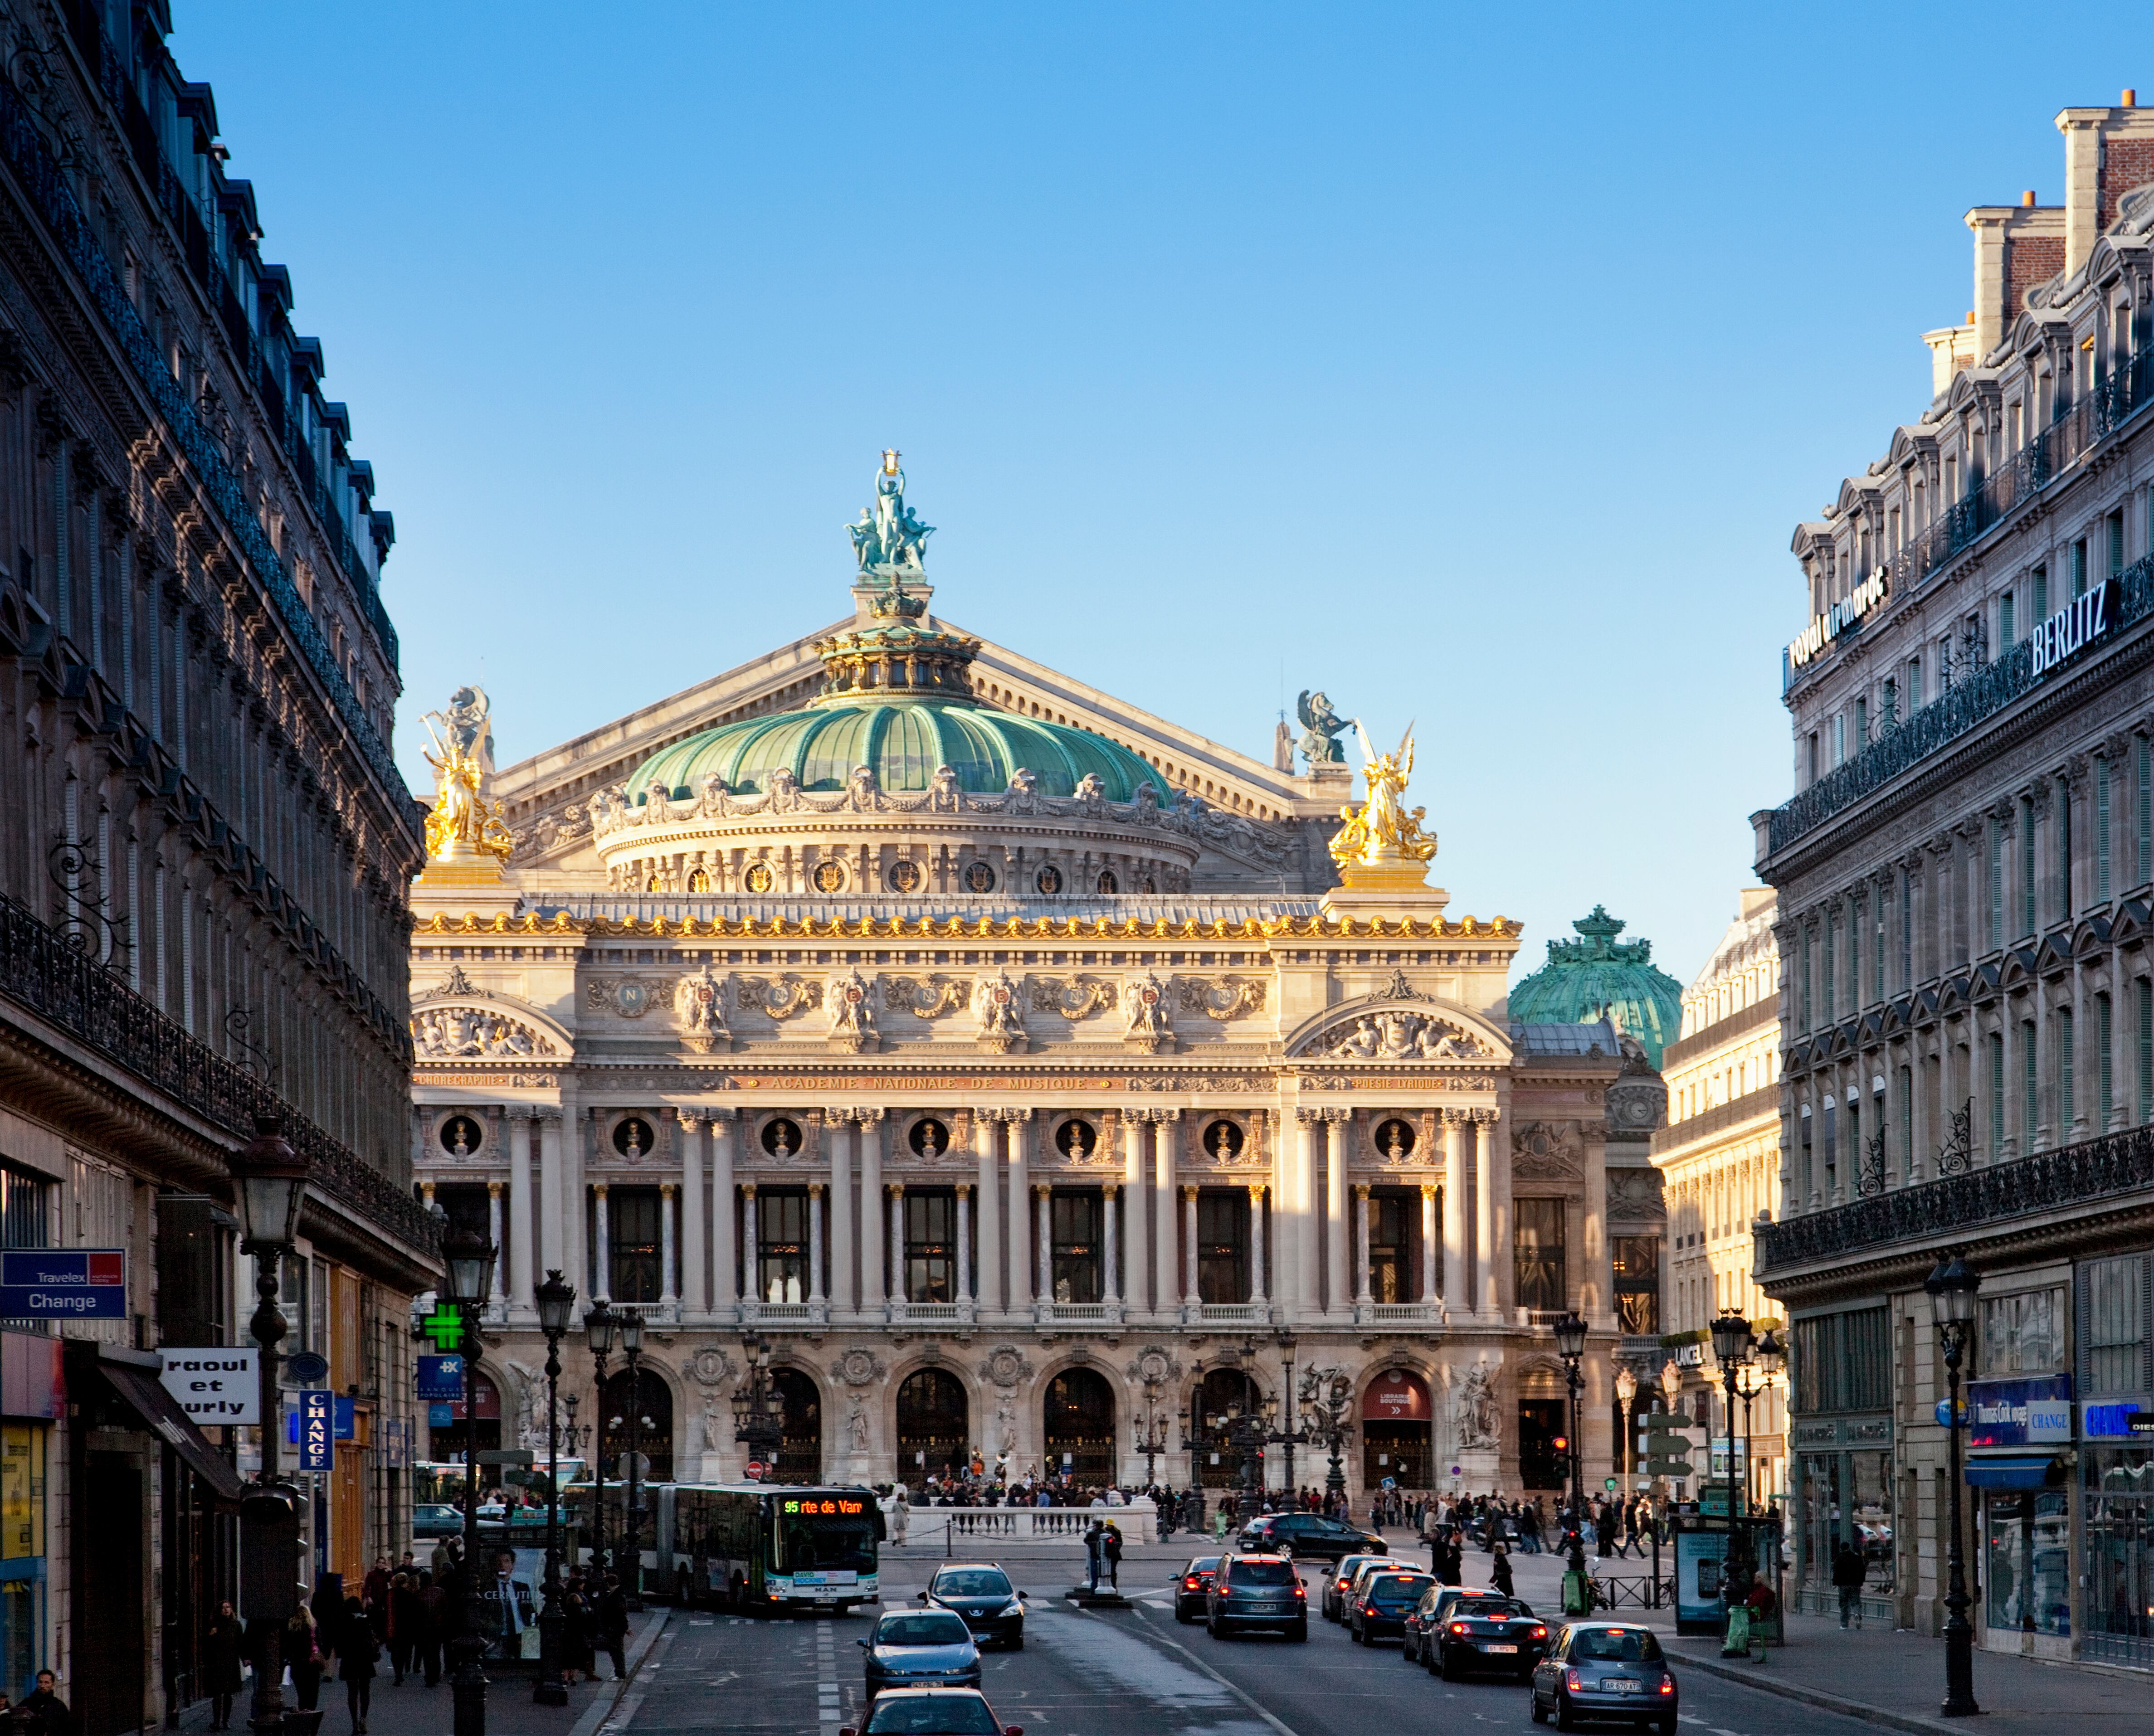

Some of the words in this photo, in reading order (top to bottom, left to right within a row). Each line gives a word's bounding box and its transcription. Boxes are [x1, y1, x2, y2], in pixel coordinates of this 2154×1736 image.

[1789, 613, 1823, 669] royal
[1823, 603, 1841, 643] air
[1841, 565, 1884, 635] maroc
[2032, 579, 2107, 677] BERLITZ
[701, 991, 708, 1000] E
[850, 992, 858, 1000] E
[998, 992, 1005, 1001] E
[1146, 993, 1153, 1002] E
[419, 1075, 499, 1085] CHOREGRAPHIE
[772, 1078, 859, 1089] ACADEMIE
[873, 1078, 957, 1089] NATIONALE
[971, 1078, 995, 1089] DE
[1008, 1079, 1087, 1089] MUSIQUE
[1356, 1079, 1393, 1089] POESIE
[1398, 1080, 1438, 1089] LYRIQUE
[37, 1272, 86, 1284] Travelex
[29, 1293, 97, 1312] Change
[1675, 1344, 1703, 1366] LANCEL
[169, 1359, 247, 1371] raoul
[190, 1380, 224, 1391] et
[181, 1400, 245, 1415] urly
[1978, 1403, 1998, 1423] Thomas
[1998, 1401, 2011, 1423] Cook
[2032, 1414, 2067, 1429] CHANGE
[308, 1394, 326, 1467] CHANGE
[785, 1501, 799, 1513] 95
[801, 1501, 818, 1513] rte
[821, 1500, 835, 1513] de
